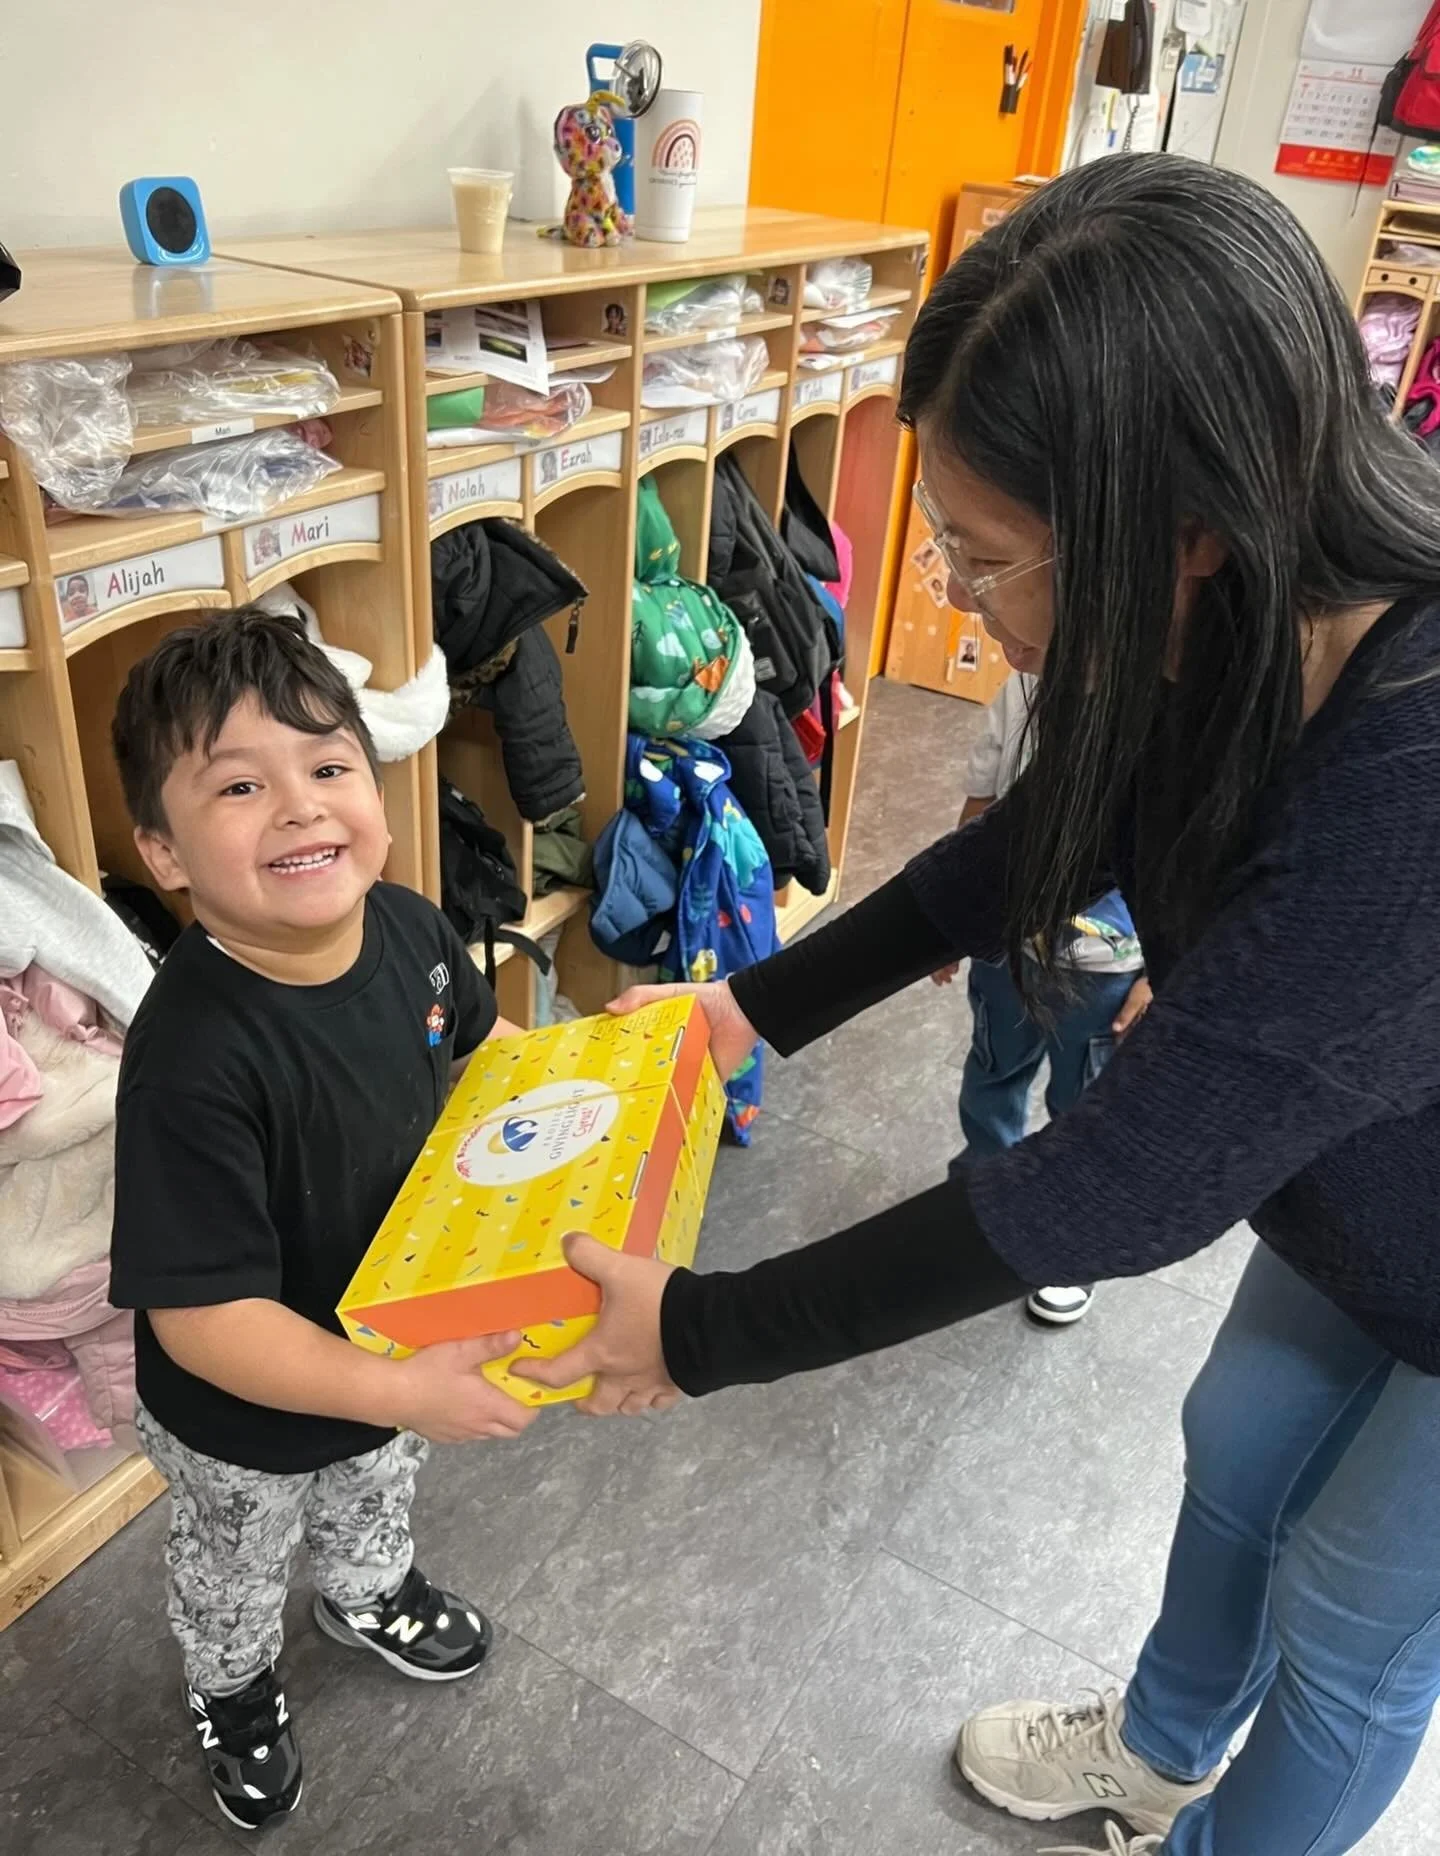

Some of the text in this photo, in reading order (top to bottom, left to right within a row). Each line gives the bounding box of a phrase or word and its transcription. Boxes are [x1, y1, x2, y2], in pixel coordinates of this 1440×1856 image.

[560, 444, 593, 471] Ezrah
[448, 473, 486, 501] Nolah
[291, 515, 329, 547] Mari
[107, 560, 165, 598] Alijah
[1083, 1772, 1127, 1798] N
